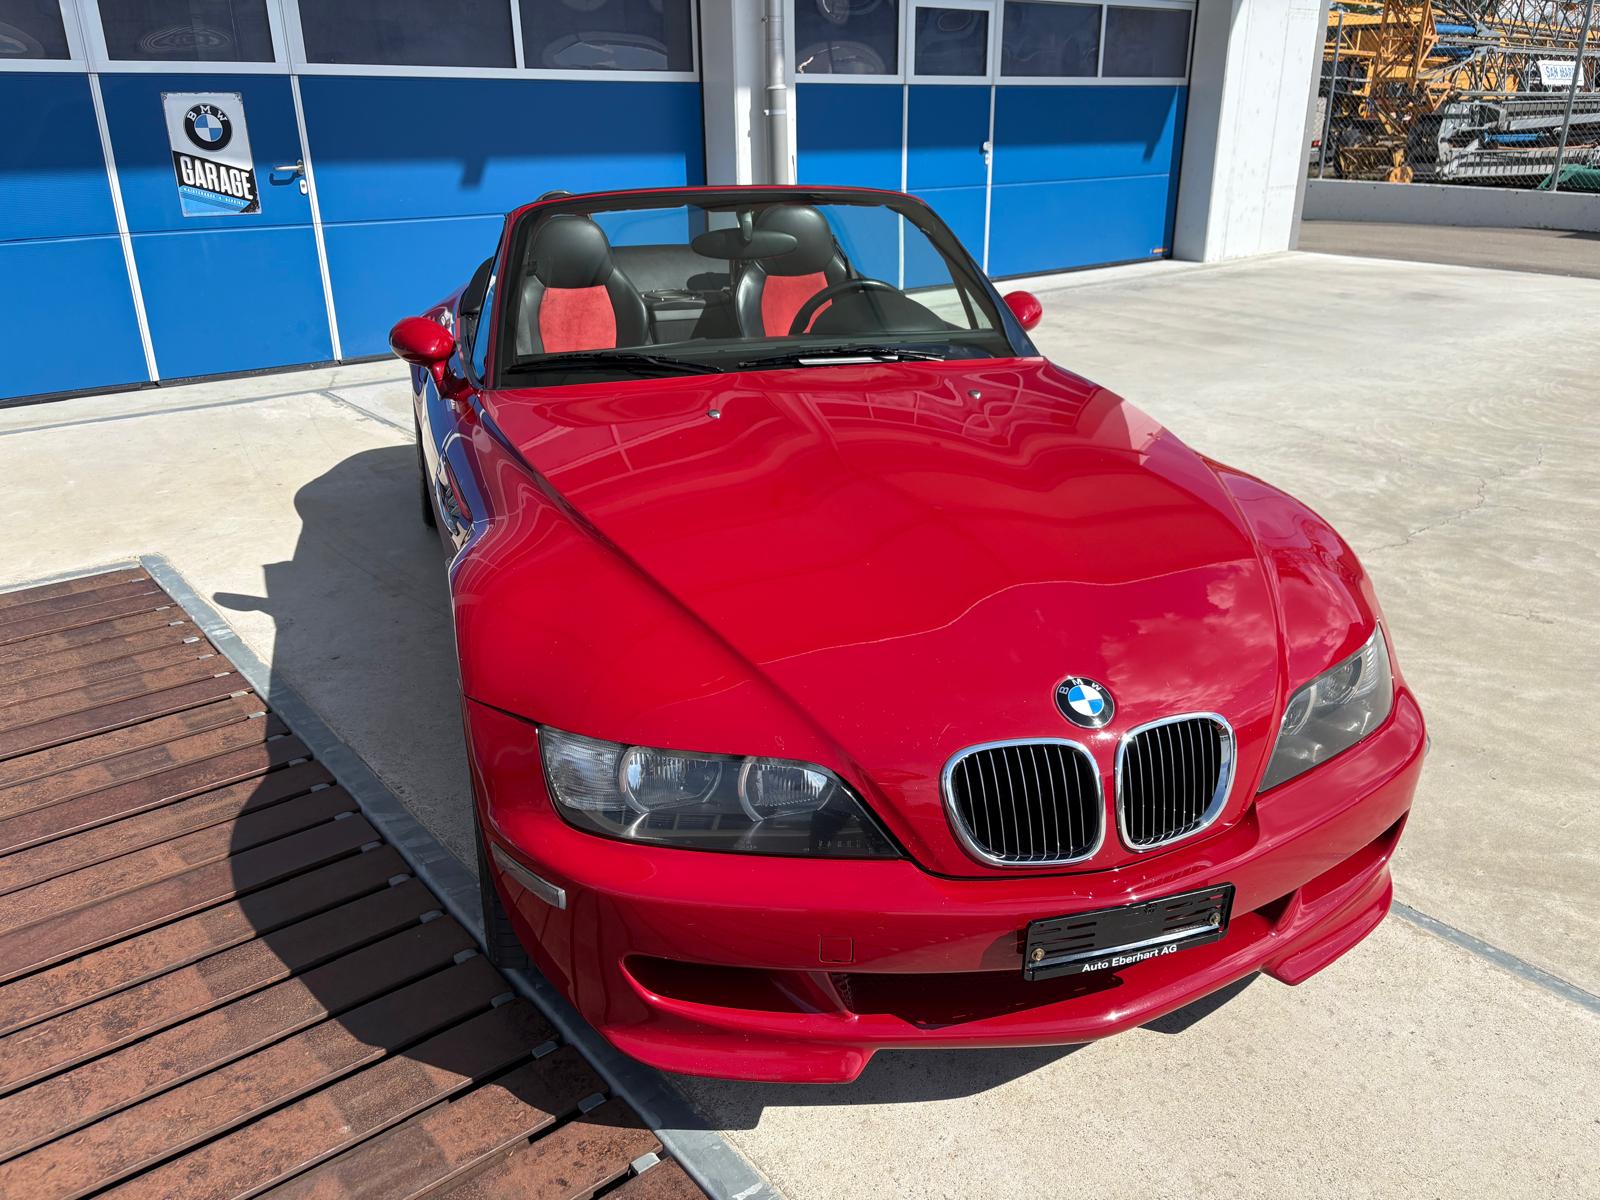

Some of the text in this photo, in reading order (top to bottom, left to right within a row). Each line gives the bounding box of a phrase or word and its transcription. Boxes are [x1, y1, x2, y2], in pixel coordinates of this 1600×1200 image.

[187, 105, 228, 122] BMW
[180, 155, 254, 200] GARAGE
[1059, 678, 1102, 695] BMW
[1082, 944, 1178, 973] Auto Eberhart AG
